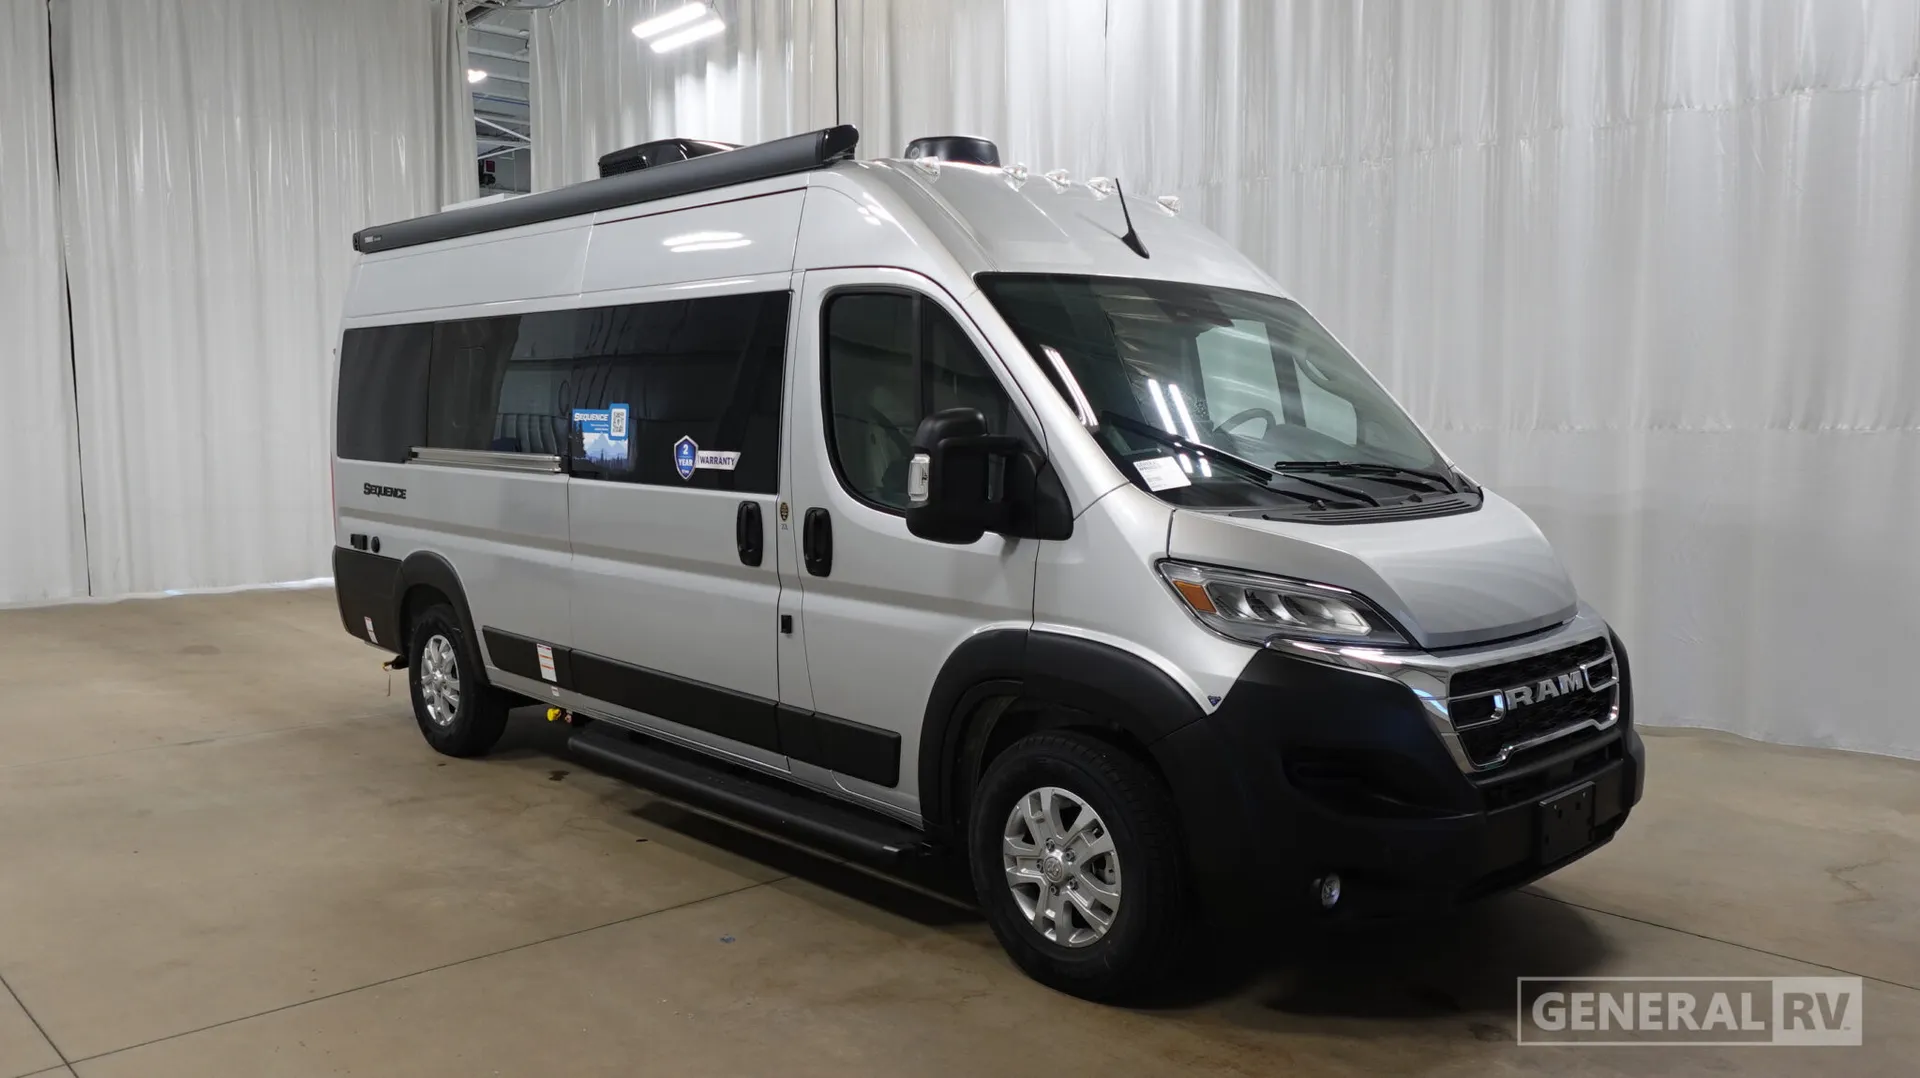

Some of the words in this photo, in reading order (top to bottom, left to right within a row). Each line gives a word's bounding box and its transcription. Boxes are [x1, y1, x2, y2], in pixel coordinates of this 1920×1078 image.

[573, 412, 609, 421] SEQUENCE
[682, 444, 689, 455] 2
[678, 458, 694, 467] YEAR
[699, 456, 735, 466] WARRANTY
[363, 482, 407, 500] SEQUENCE
[1503, 670, 1584, 711] RAM
